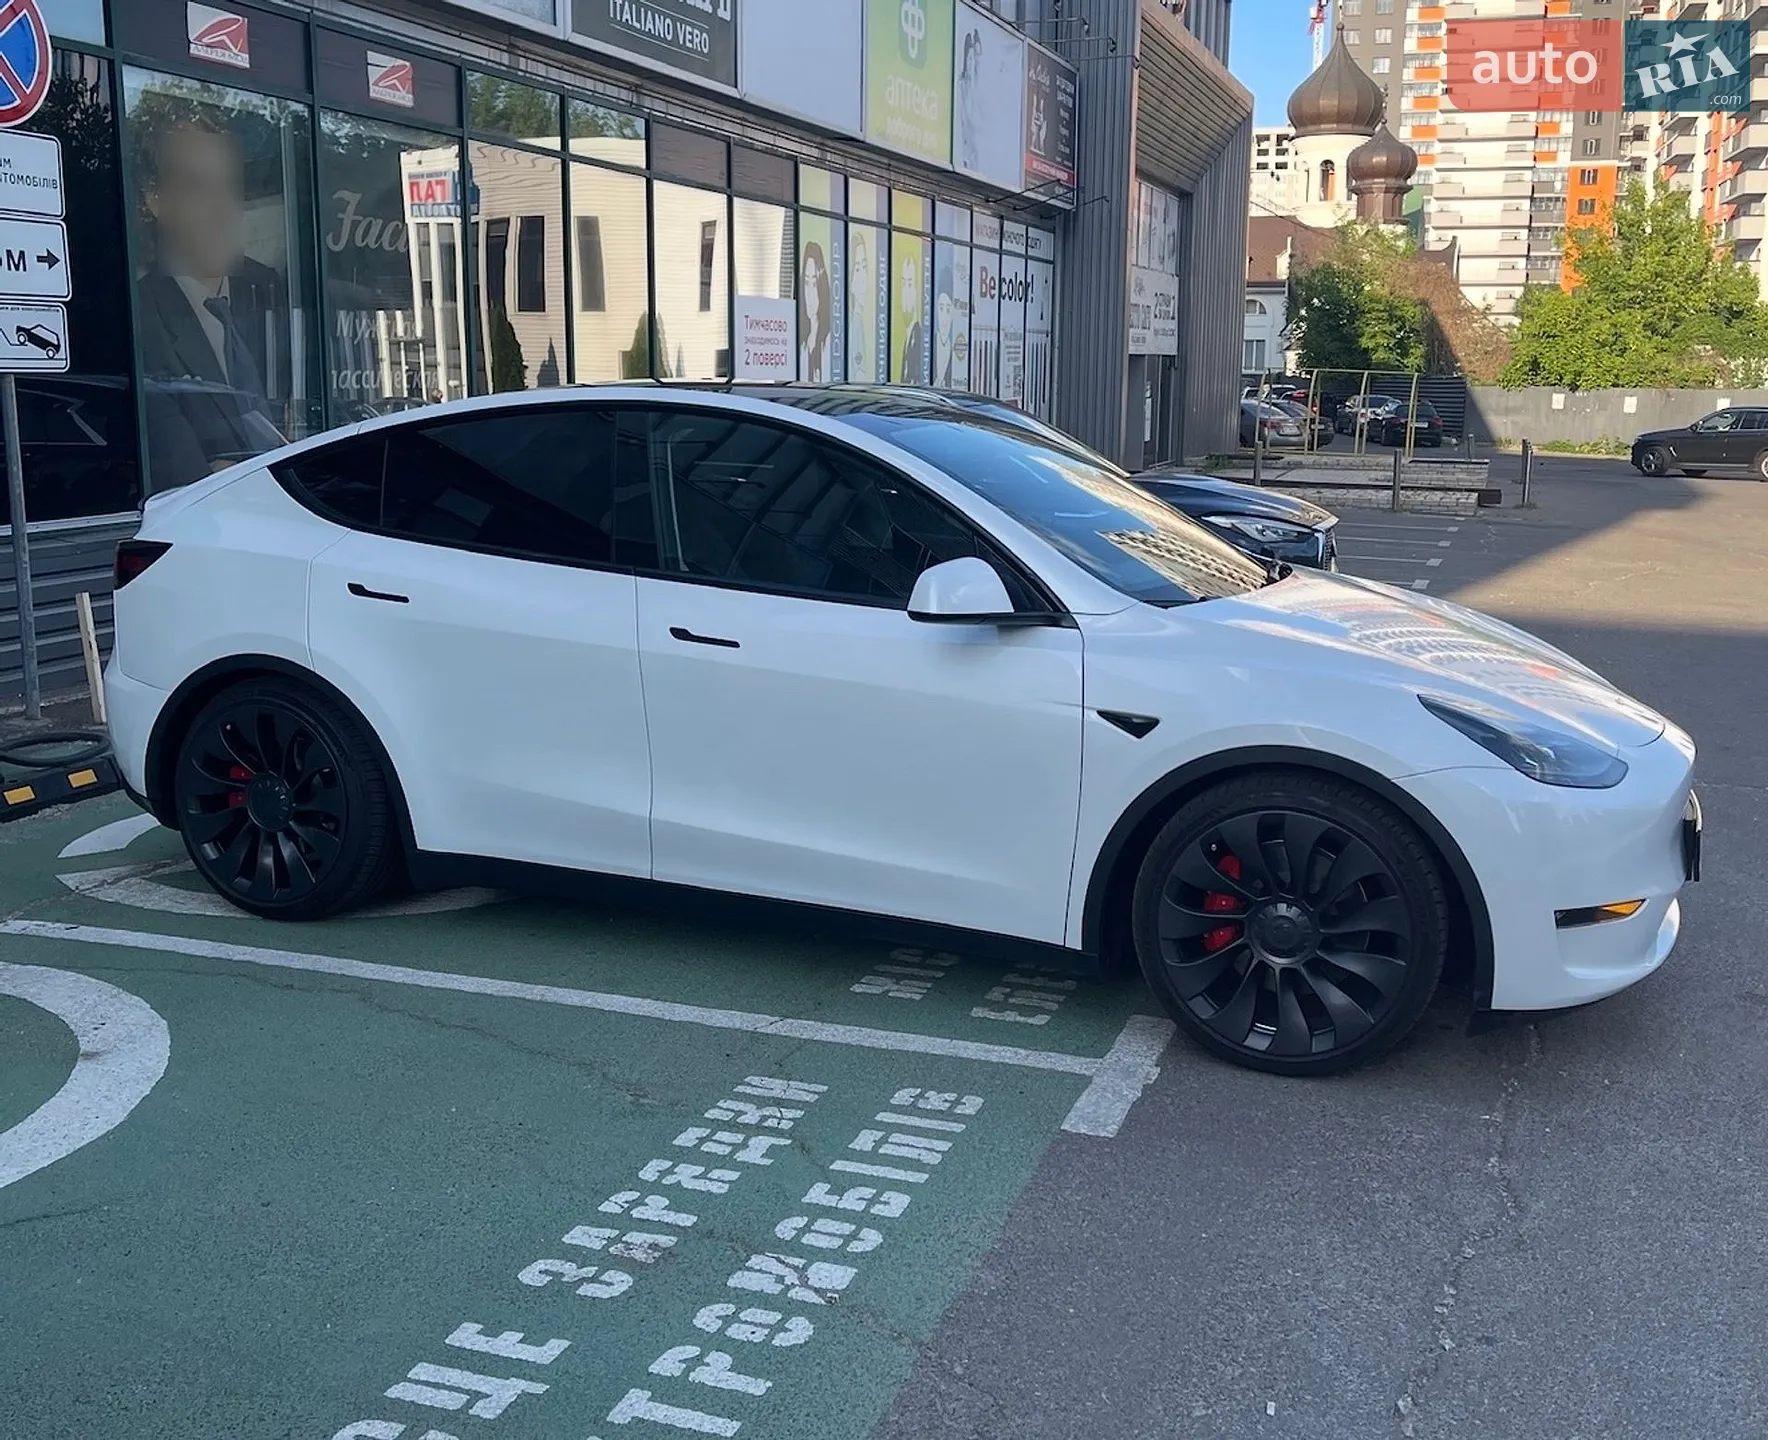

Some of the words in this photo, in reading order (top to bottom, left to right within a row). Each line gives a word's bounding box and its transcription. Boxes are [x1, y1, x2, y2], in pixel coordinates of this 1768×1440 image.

[610, 0, 673, 41] ITALIANO
[676, 21, 710, 54] VERO
[885, 74, 939, 121] аптека
[979, 266, 997, 301] Be
[1001, 271, 1034, 303] color!
[744, 314, 788, 333] Тимчасово
[744, 348, 751, 366] 2
[752, 349, 788, 369] поверсі
[517, 1076, 829, 1298] ЗАРЯДКИ
